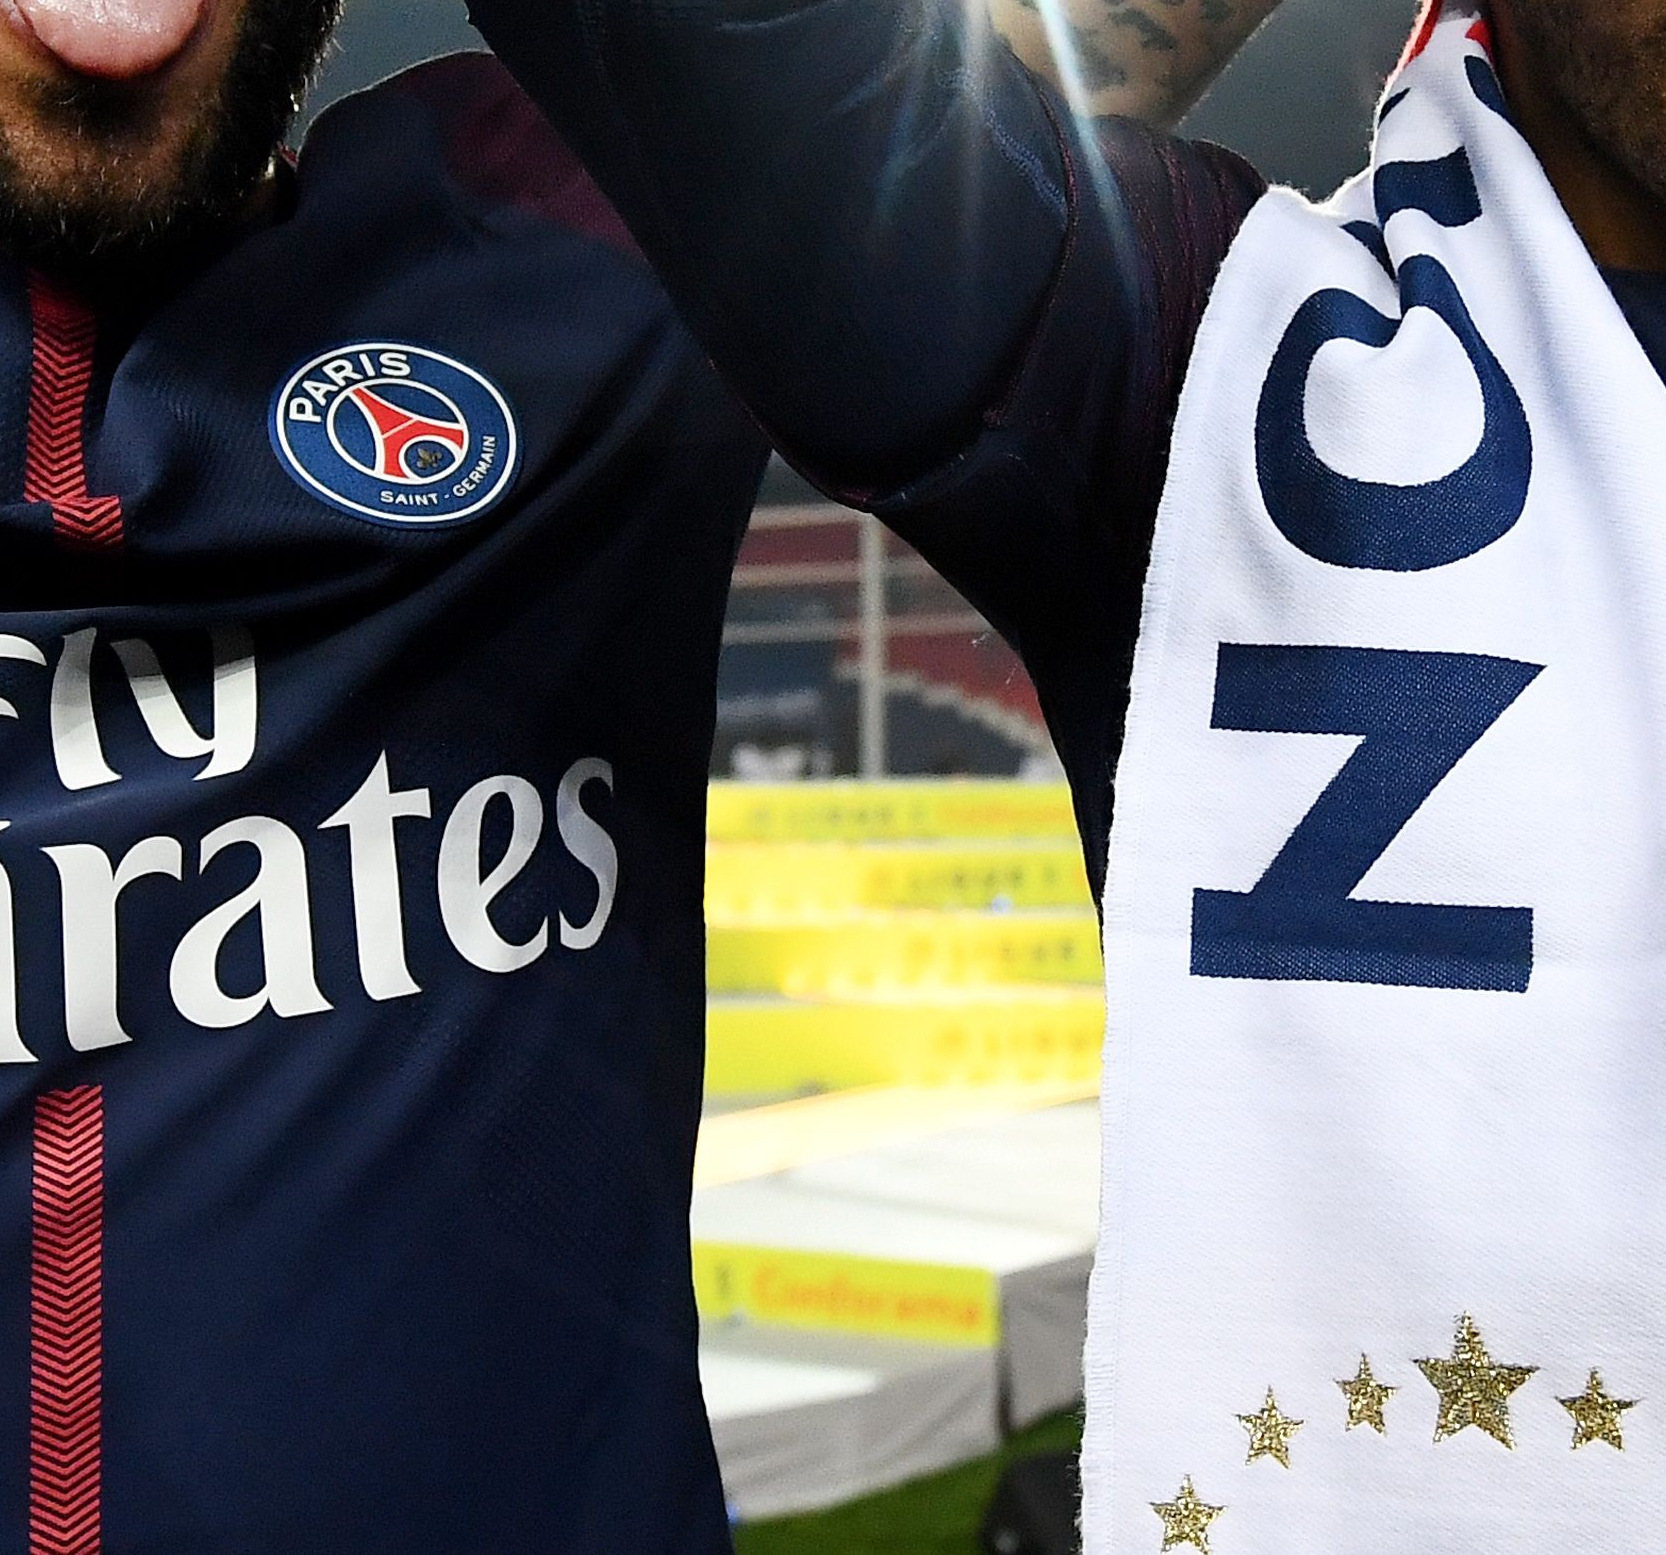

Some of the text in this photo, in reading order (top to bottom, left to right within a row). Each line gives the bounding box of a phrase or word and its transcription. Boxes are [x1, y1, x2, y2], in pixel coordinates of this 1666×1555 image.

[288, 352, 411, 424] PARIS
[380, 490, 439, 506] SAINT
[452, 435, 496, 498] GERMAIN
